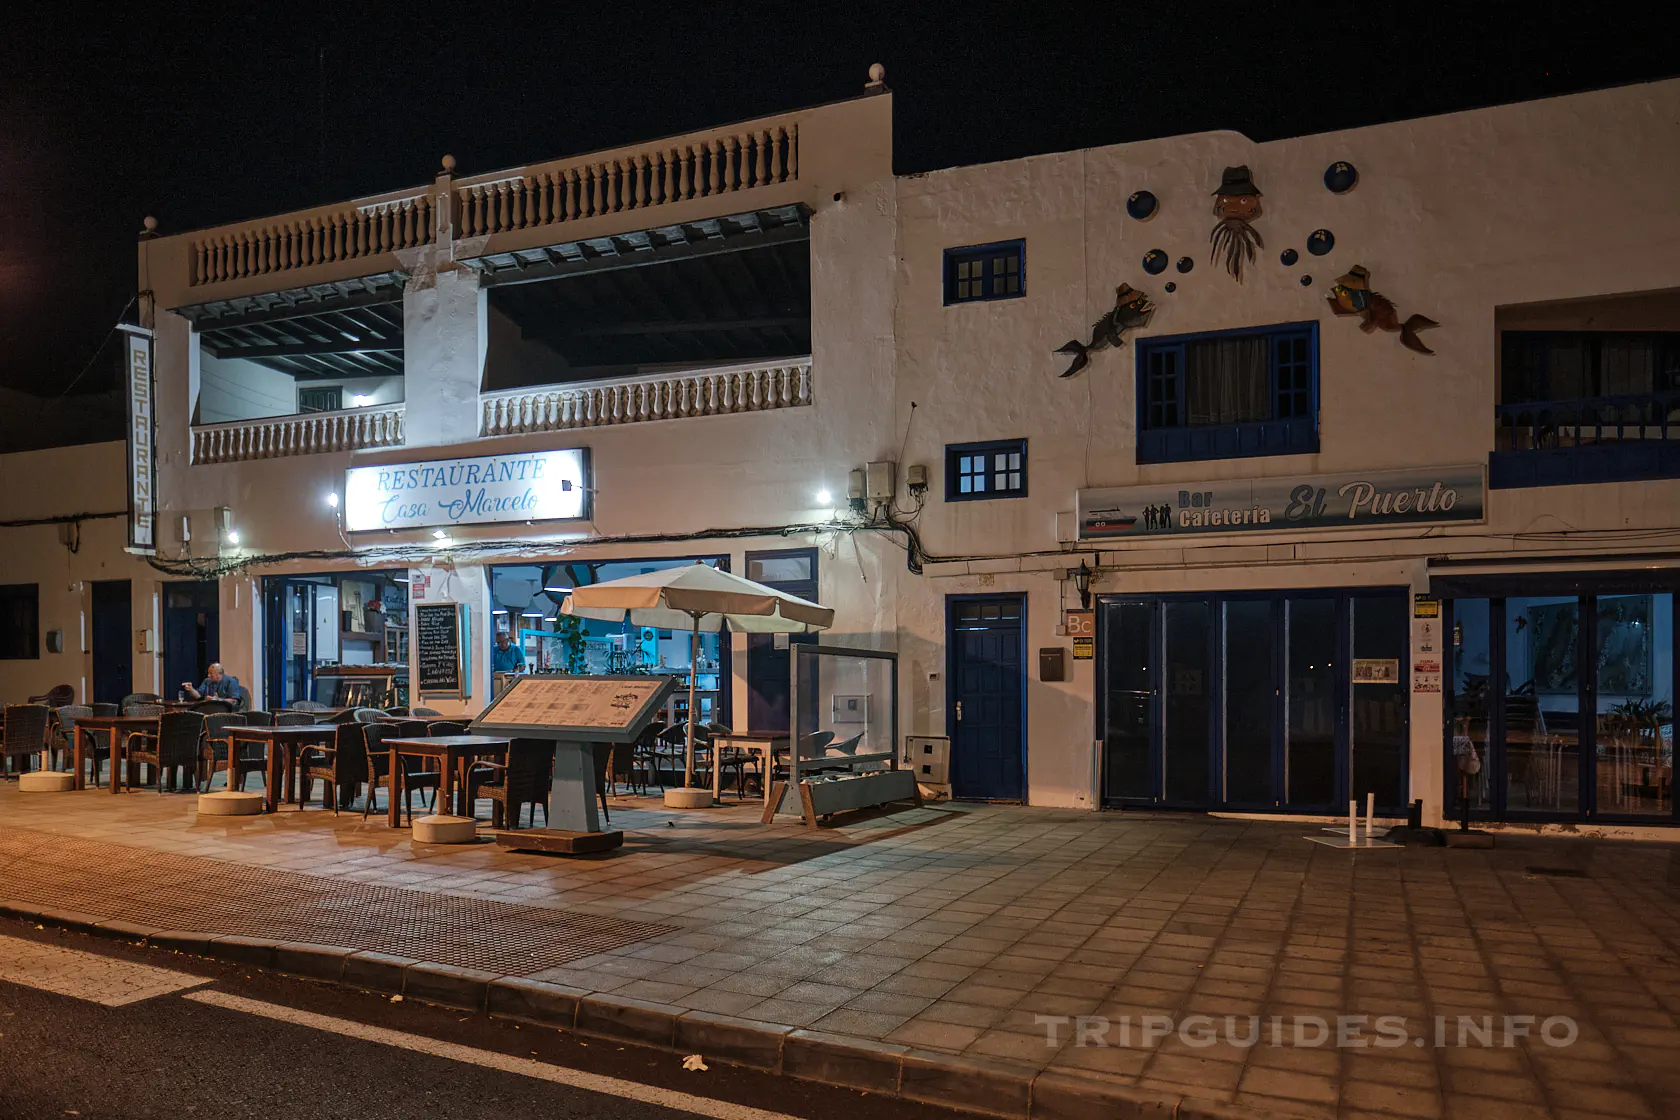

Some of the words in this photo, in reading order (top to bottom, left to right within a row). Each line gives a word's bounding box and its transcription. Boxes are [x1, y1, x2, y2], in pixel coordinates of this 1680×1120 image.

[133, 348, 149, 529] RESTAURANTE
[377, 458, 547, 491] RESTAURANTE
[377, 493, 430, 523] Casa
[438, 487, 538, 519] Marcelo
[1178, 490, 1212, 508] Bar
[1179, 504, 1271, 528] Cafetería
[1285, 484, 1327, 522] El
[1337, 481, 1463, 520] Puerto
